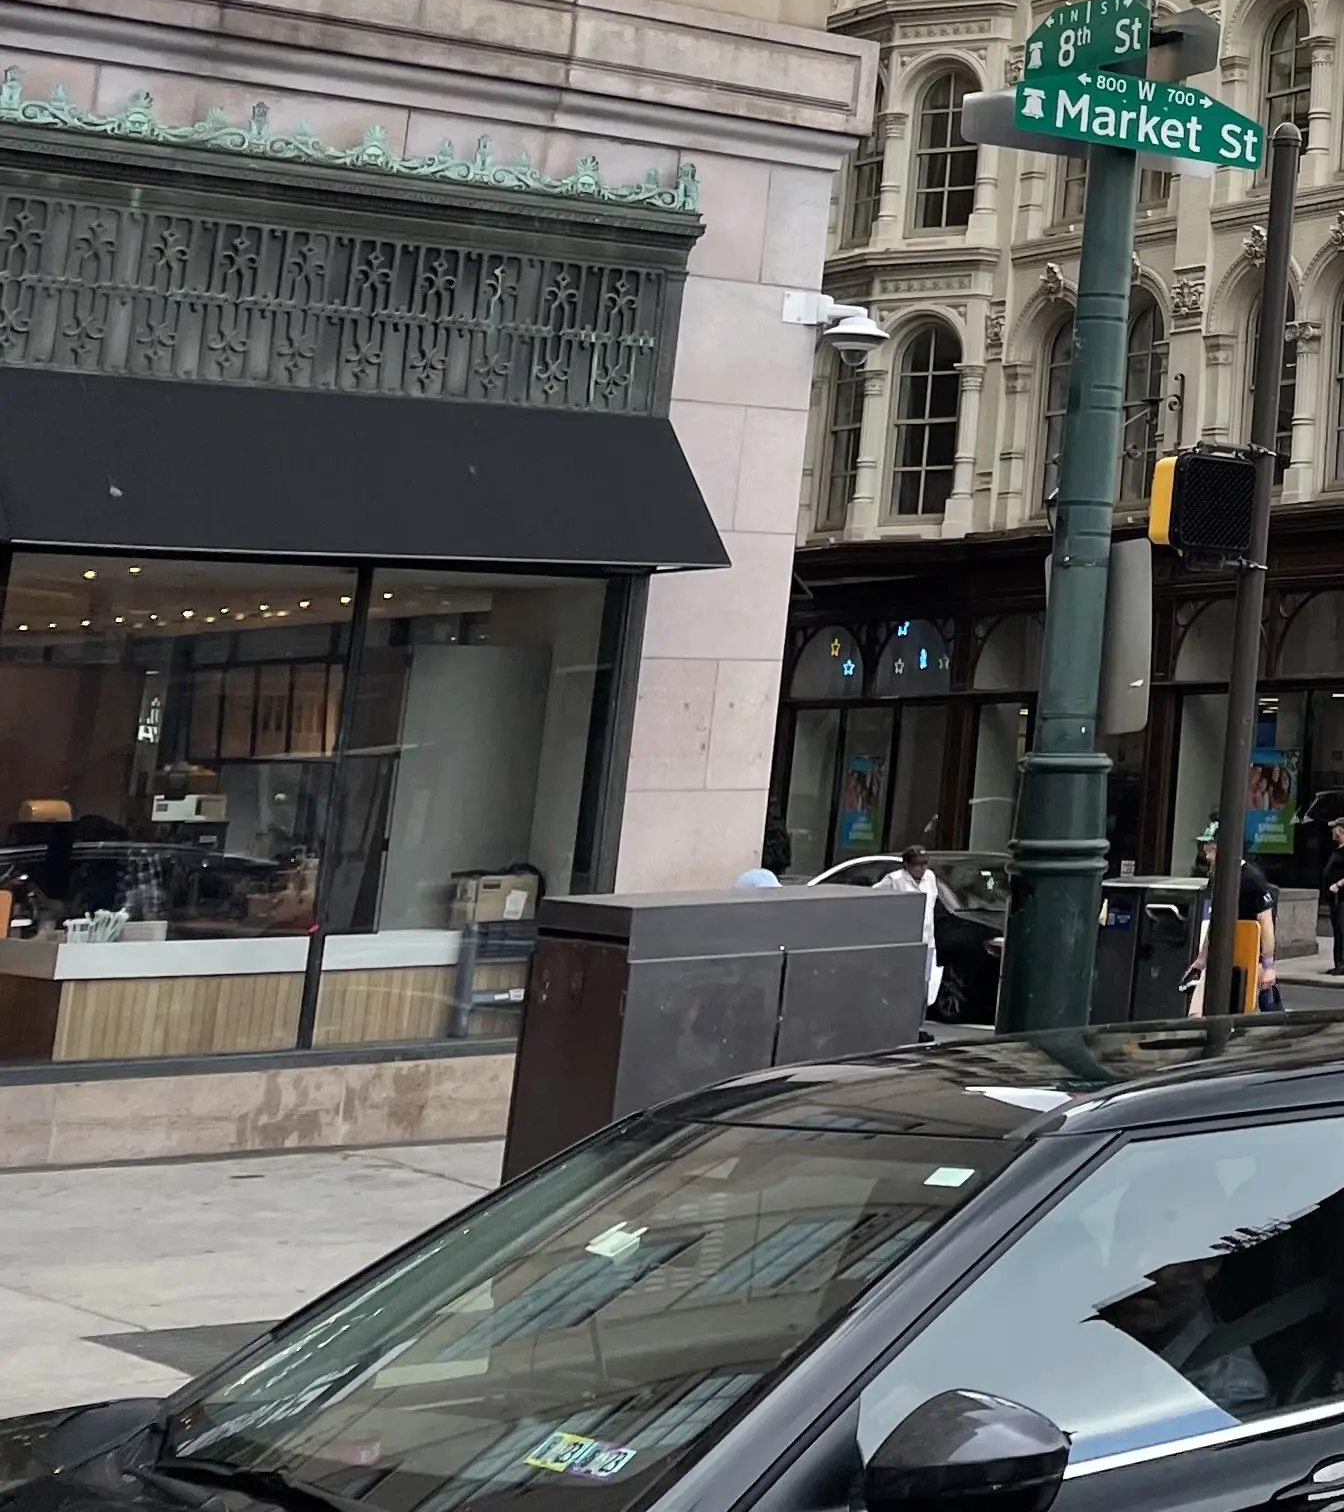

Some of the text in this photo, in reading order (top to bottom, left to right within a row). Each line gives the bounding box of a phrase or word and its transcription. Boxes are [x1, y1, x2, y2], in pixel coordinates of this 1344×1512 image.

[1058, 16, 1142, 68] 8th St
[1096, 75, 1195, 106] 800 W 700
[1055, 90, 1258, 163] Market St
